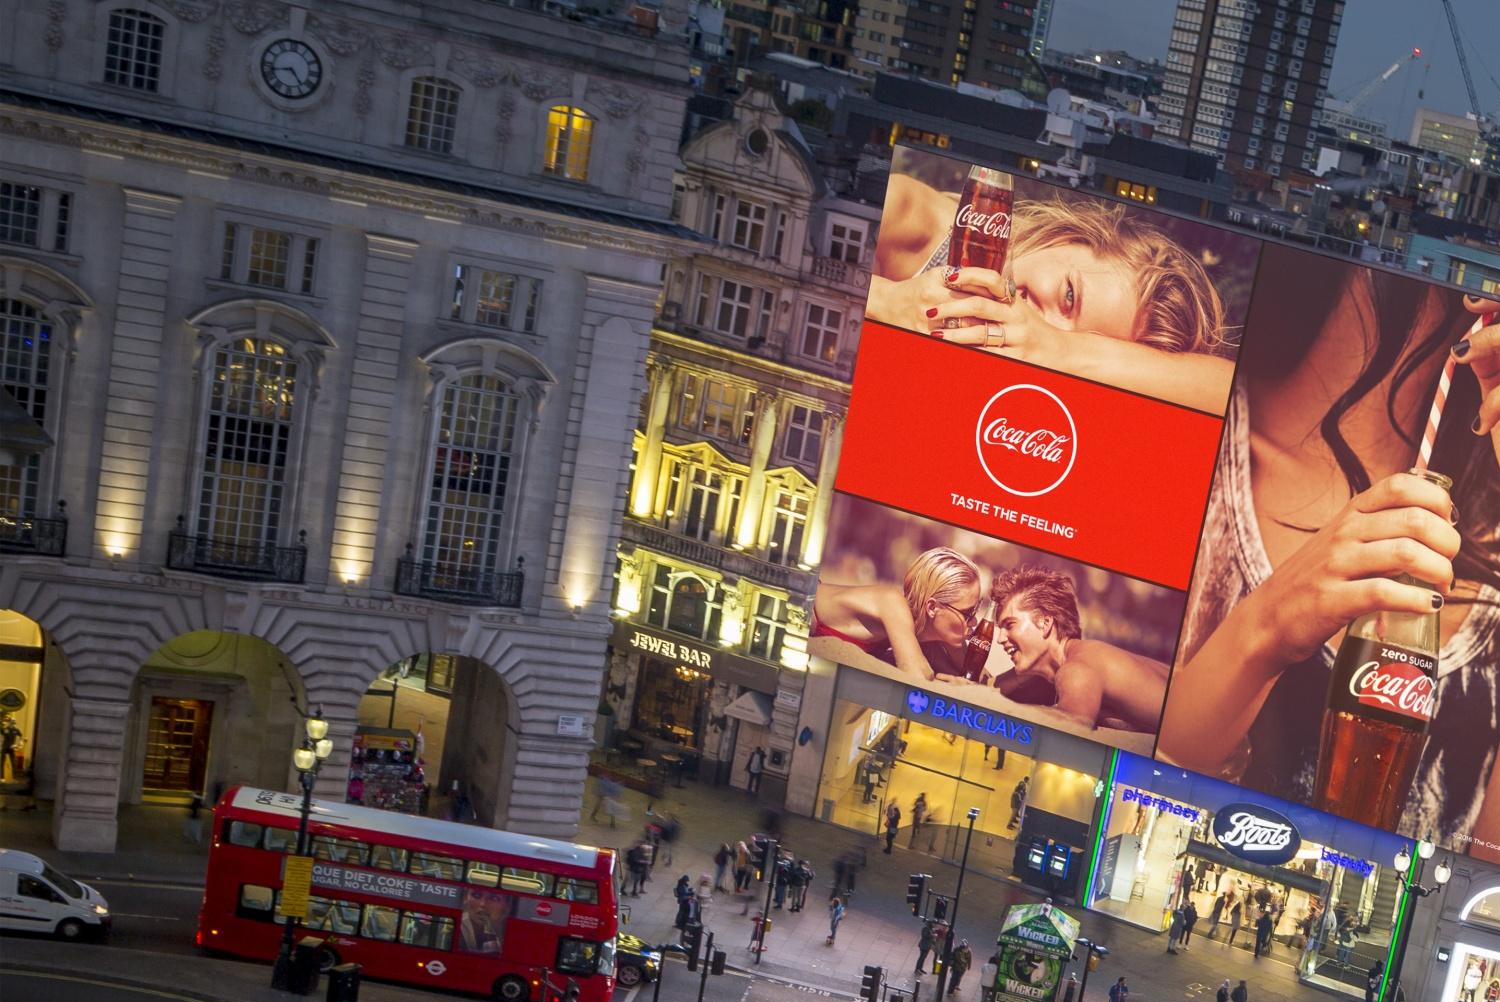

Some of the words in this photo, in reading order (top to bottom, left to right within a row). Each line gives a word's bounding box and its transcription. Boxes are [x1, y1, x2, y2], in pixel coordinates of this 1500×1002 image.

[956, 204, 1011, 239] Coca-Cola
[983, 417, 1070, 462] Coca-Cola
[949, 492, 990, 514] TASTE
[992, 505, 1018, 522] THE
[1020, 514, 1077, 539] FEELING
[629, 631, 677, 660] JEWEL
[680, 645, 712, 669] BAR
[1381, 648, 1407, 662] zero
[1408, 656, 1433, 671] SUGAR
[1349, 661, 1437, 717] Coca-Cola
[931, 698, 1034, 744] BARCLAYS
[1122, 788, 1200, 823] pharmacy
[1218, 812, 1292, 851] Boots
[1473, 837, 1485, 847] The
[1320, 847, 1374, 878] beauty
[312, 865, 341, 878] QUE
[344, 869, 374, 882] DIET
[419, 883, 457, 897] TASTE
[312, 875, 341, 887] UGAR,
[344, 880, 359, 890] NO
[362, 883, 411, 899] CALORIES
